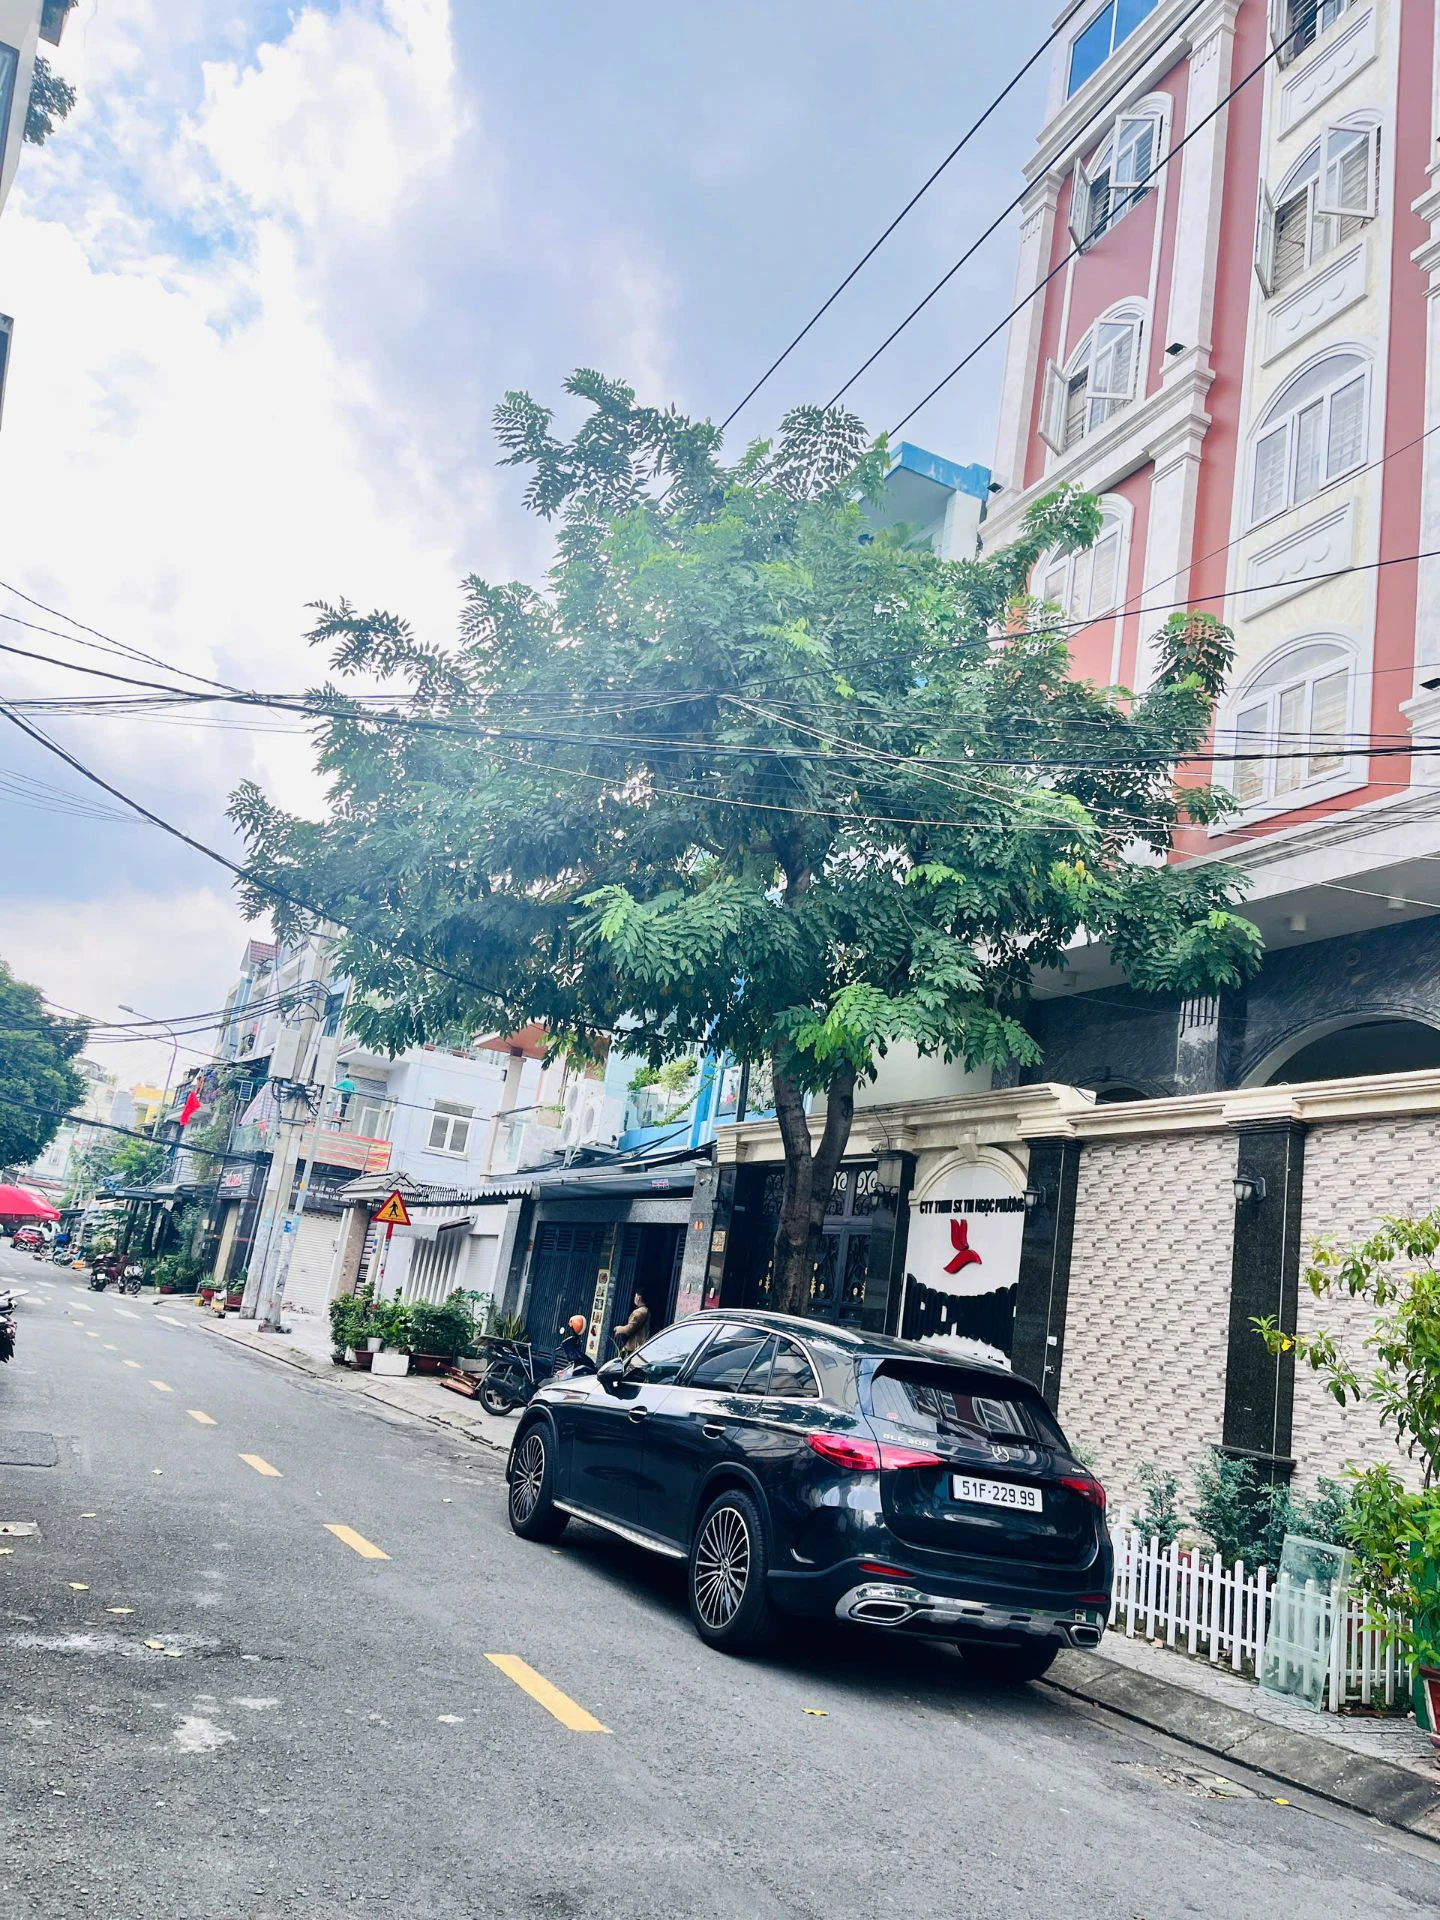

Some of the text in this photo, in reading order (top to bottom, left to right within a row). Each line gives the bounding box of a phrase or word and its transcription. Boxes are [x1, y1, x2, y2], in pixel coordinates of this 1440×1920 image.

[920, 1201, 934, 1214] CTY
[953, 1200, 963, 1213] SX
[975, 1199, 995, 1217] NGỌC
